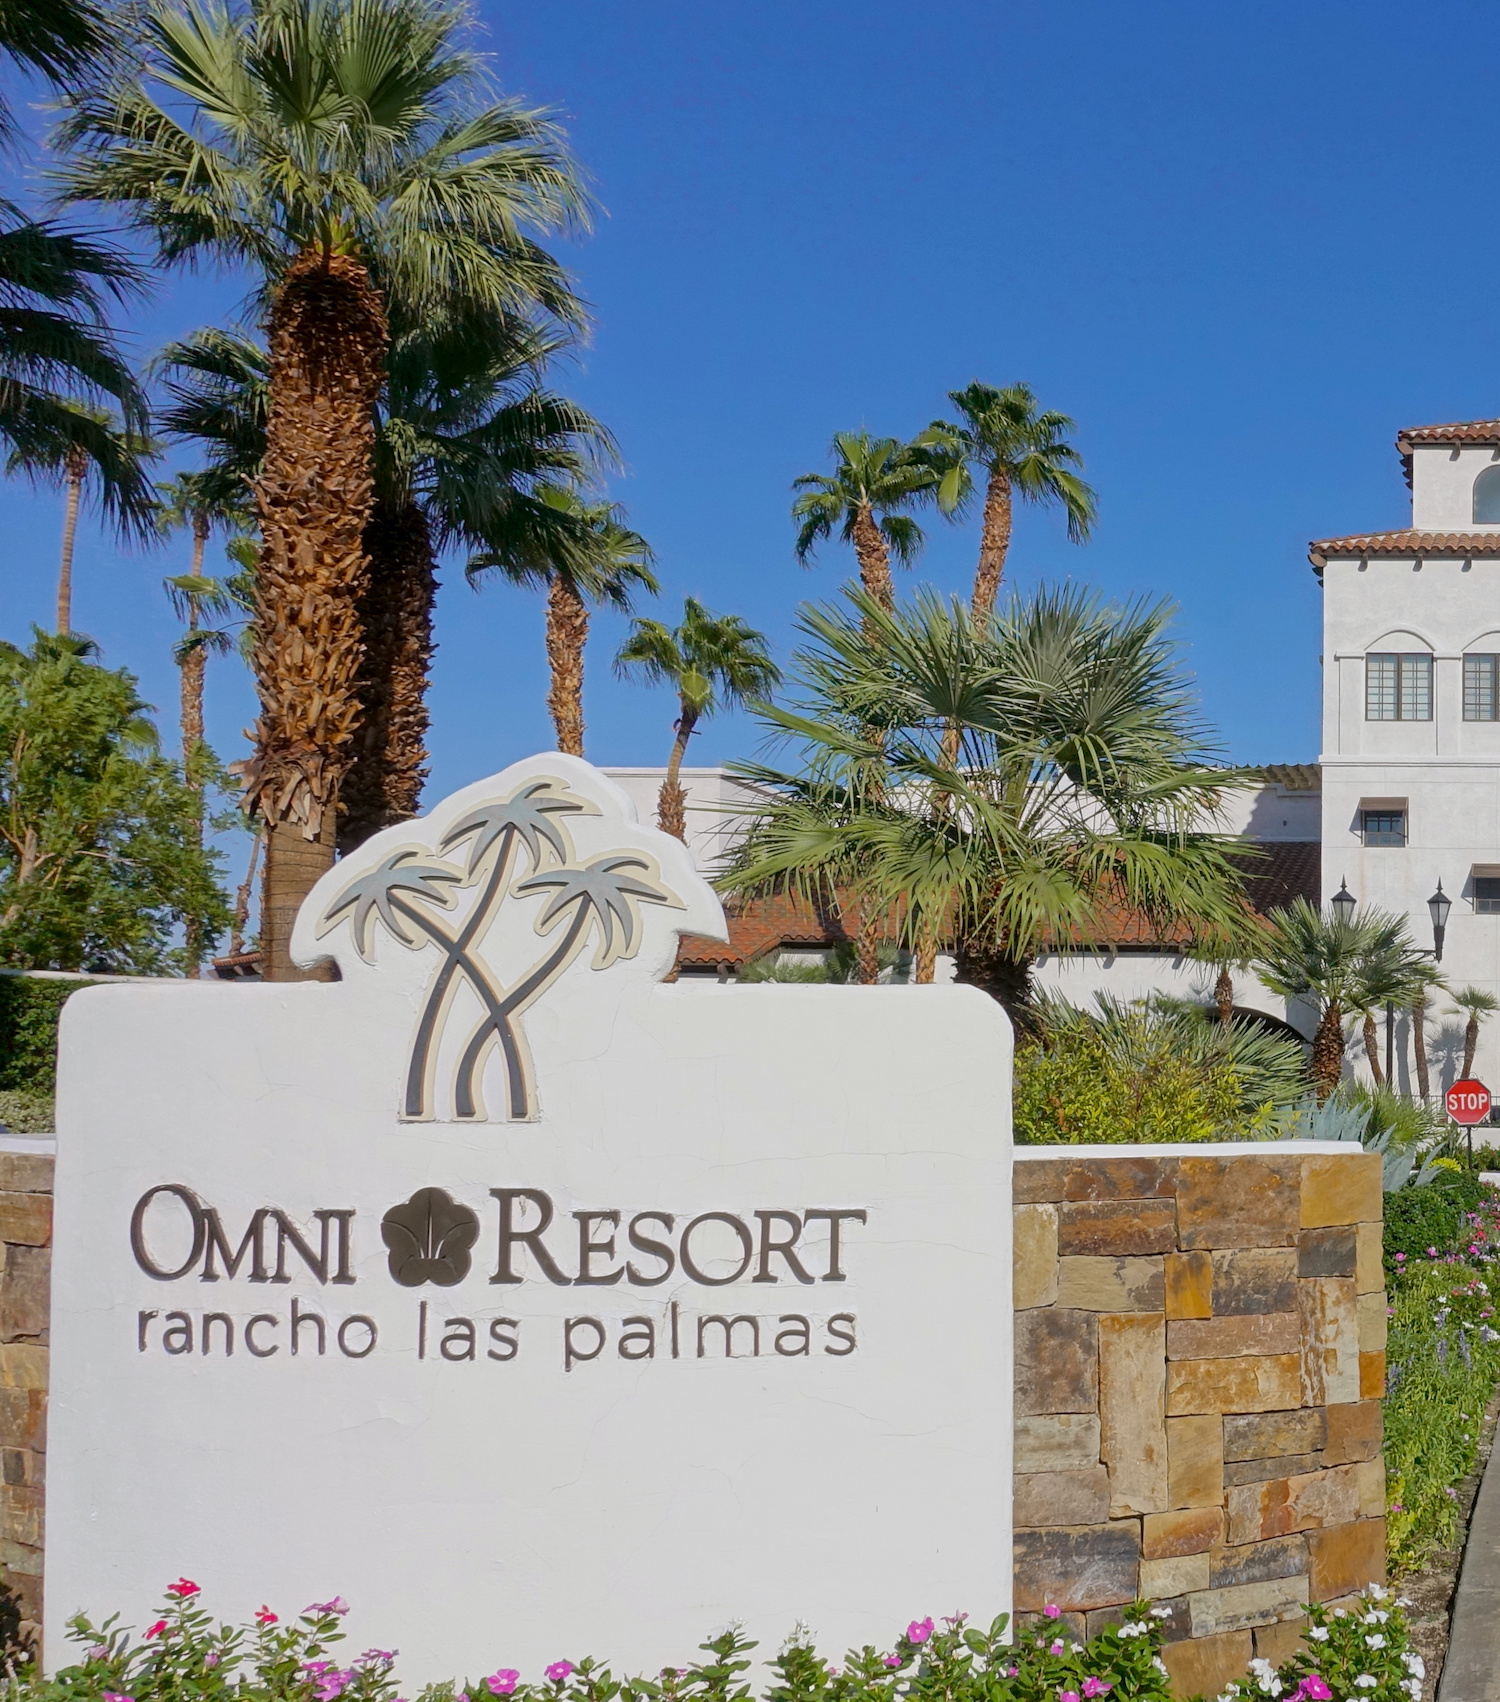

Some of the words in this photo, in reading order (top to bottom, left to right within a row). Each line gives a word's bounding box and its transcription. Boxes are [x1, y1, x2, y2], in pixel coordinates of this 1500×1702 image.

[1448, 1093, 1488, 1110] STOP
[130, 1183, 357, 1285] OMNI
[488, 1187, 867, 1287] RESORT
[138, 1297, 377, 1359] rancho
[418, 1300, 520, 1362] las
[564, 1300, 858, 1373] palmas
